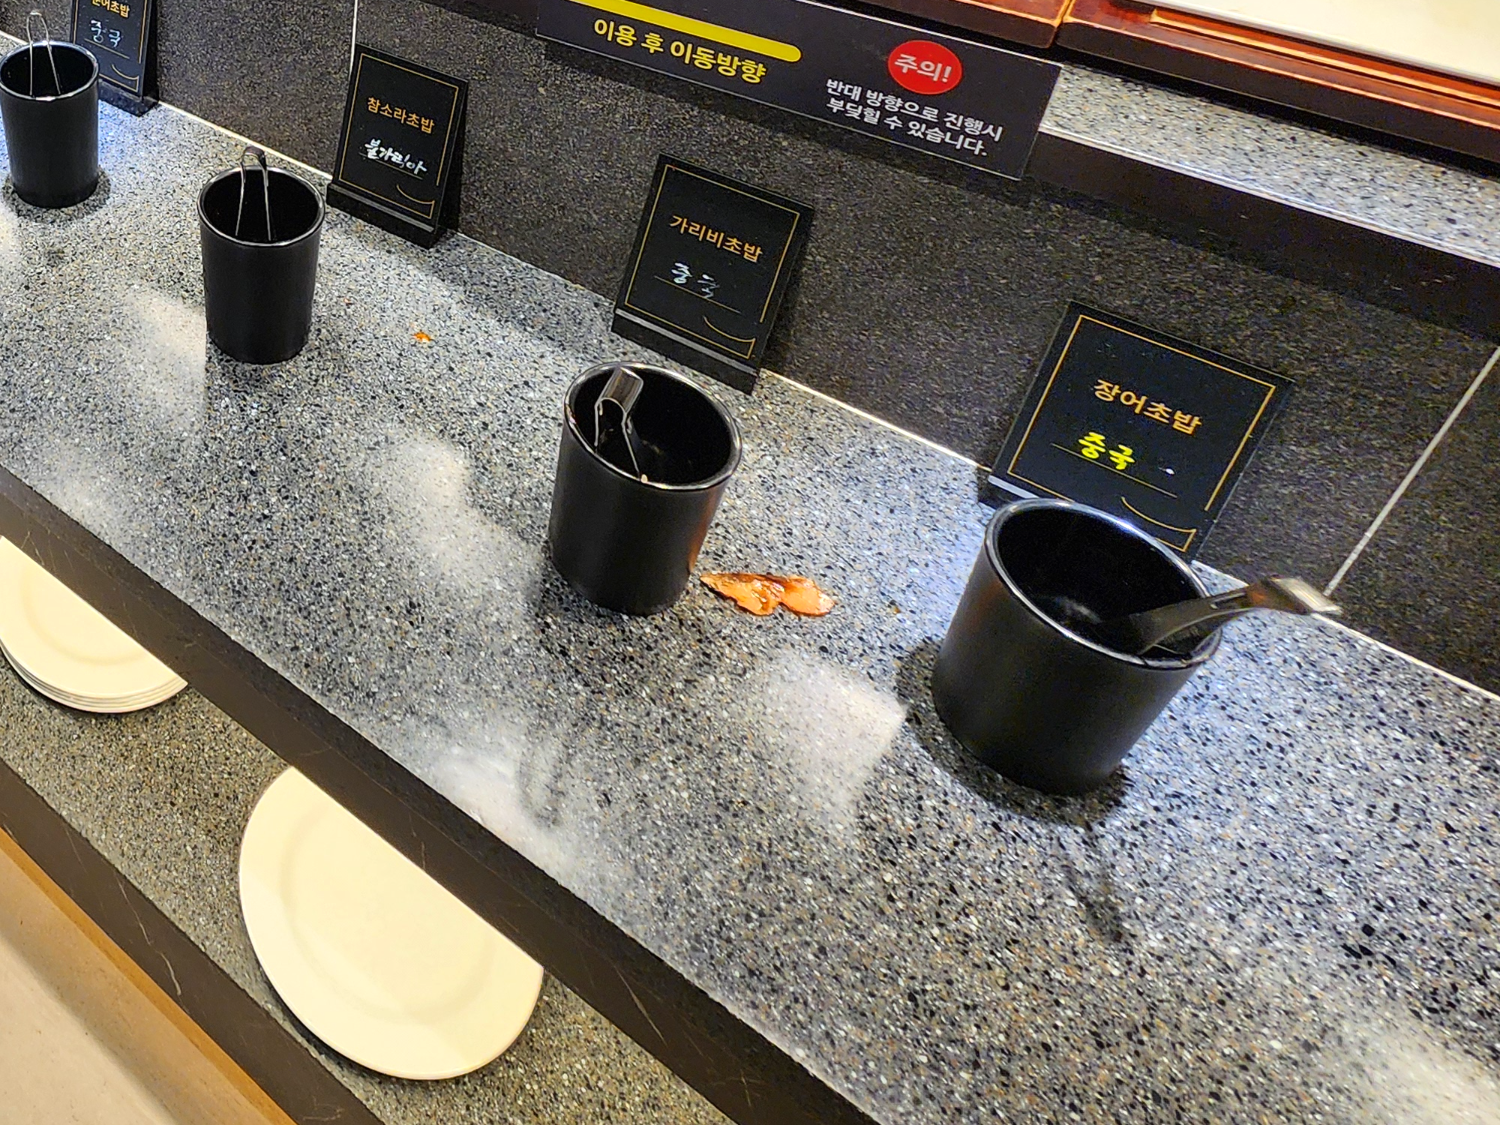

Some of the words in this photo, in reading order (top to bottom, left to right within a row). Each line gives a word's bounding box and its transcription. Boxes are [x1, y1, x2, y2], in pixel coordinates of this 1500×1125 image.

[594, 18, 638, 47] 이용
[640, 32, 664, 54] 후
[669, 40, 768, 85] 이동방향
[894, 53, 953, 83] 주의!
[366, 96, 435, 135] 참소라초밥
[826, 78, 863, 101] 반대
[866, 89, 940, 123] 방향으로
[943, 112, 1004, 142] 진행시
[883, 113, 904, 131] 수
[907, 120, 989, 157] 있습니다.
[669, 214, 764, 264] 가리비초밥
[1093, 378, 1203, 437] 장어초밥
[1077, 430, 1136, 471] 중국
